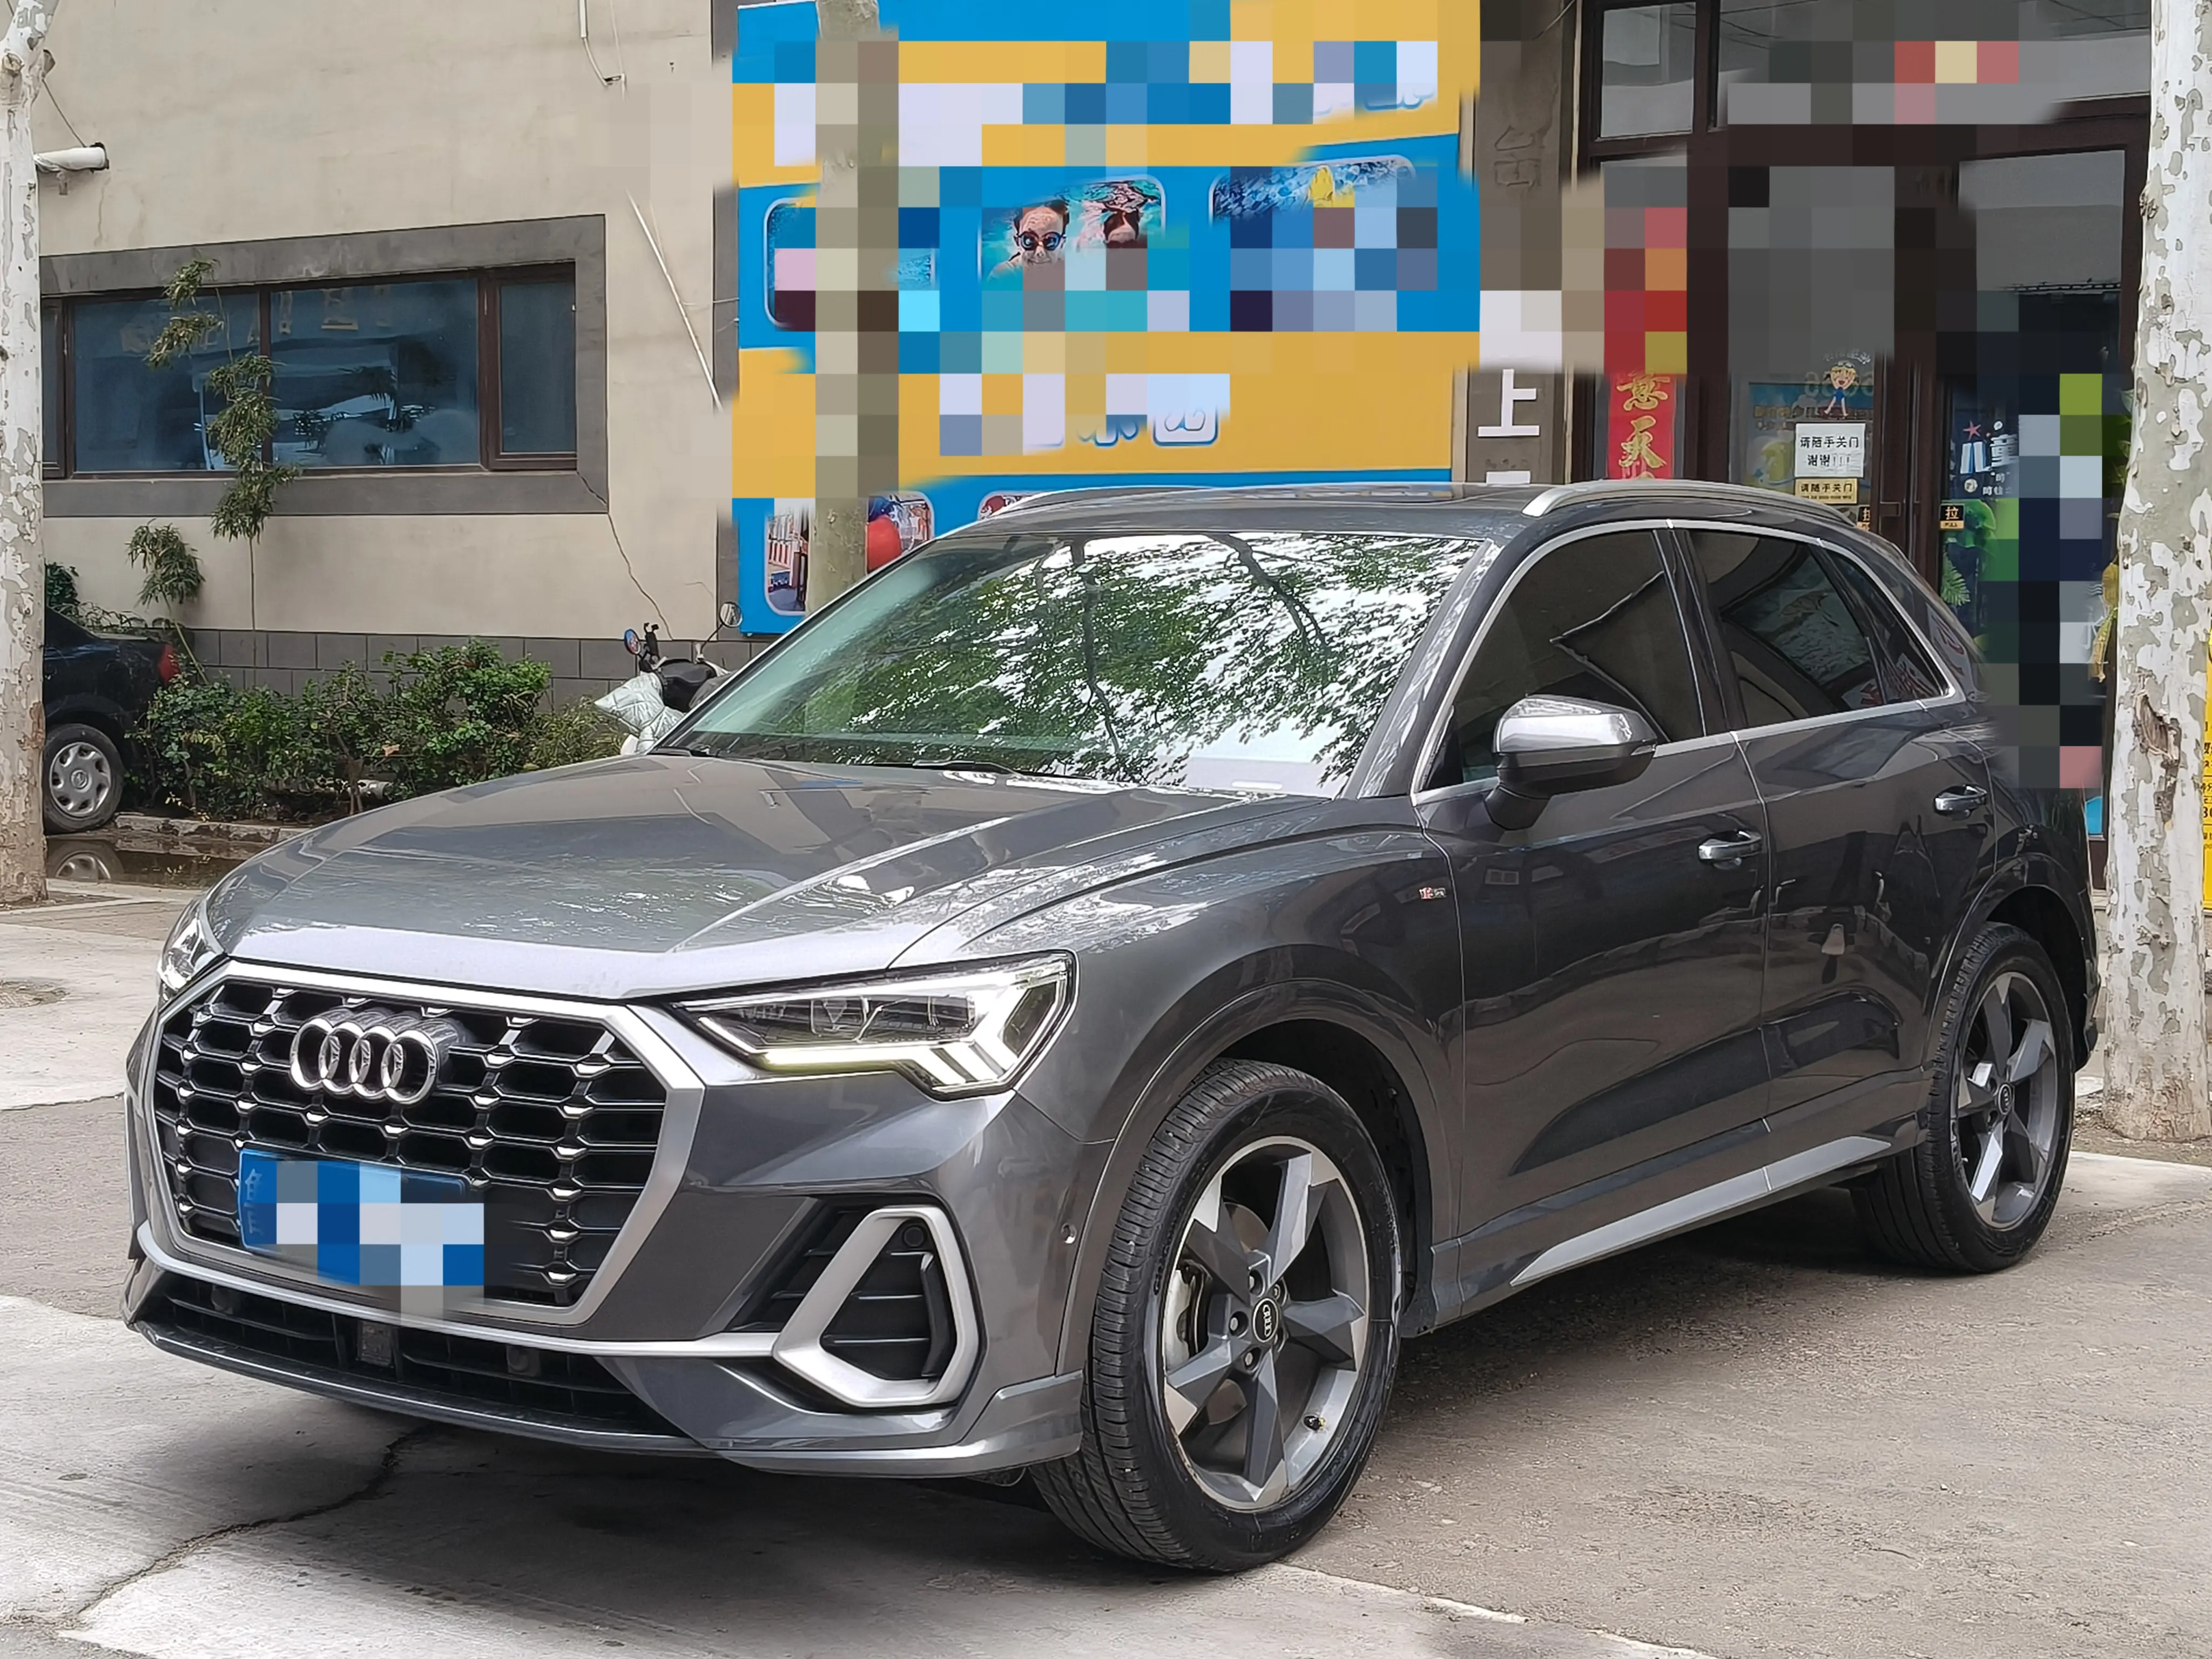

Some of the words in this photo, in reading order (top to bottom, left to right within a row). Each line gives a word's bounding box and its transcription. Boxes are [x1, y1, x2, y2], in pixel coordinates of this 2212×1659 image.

[1800, 436, 1859, 449] 请随手关门
[1800, 483, 1853, 493] 请随手关门
[1945, 506, 1959, 520] 拉
